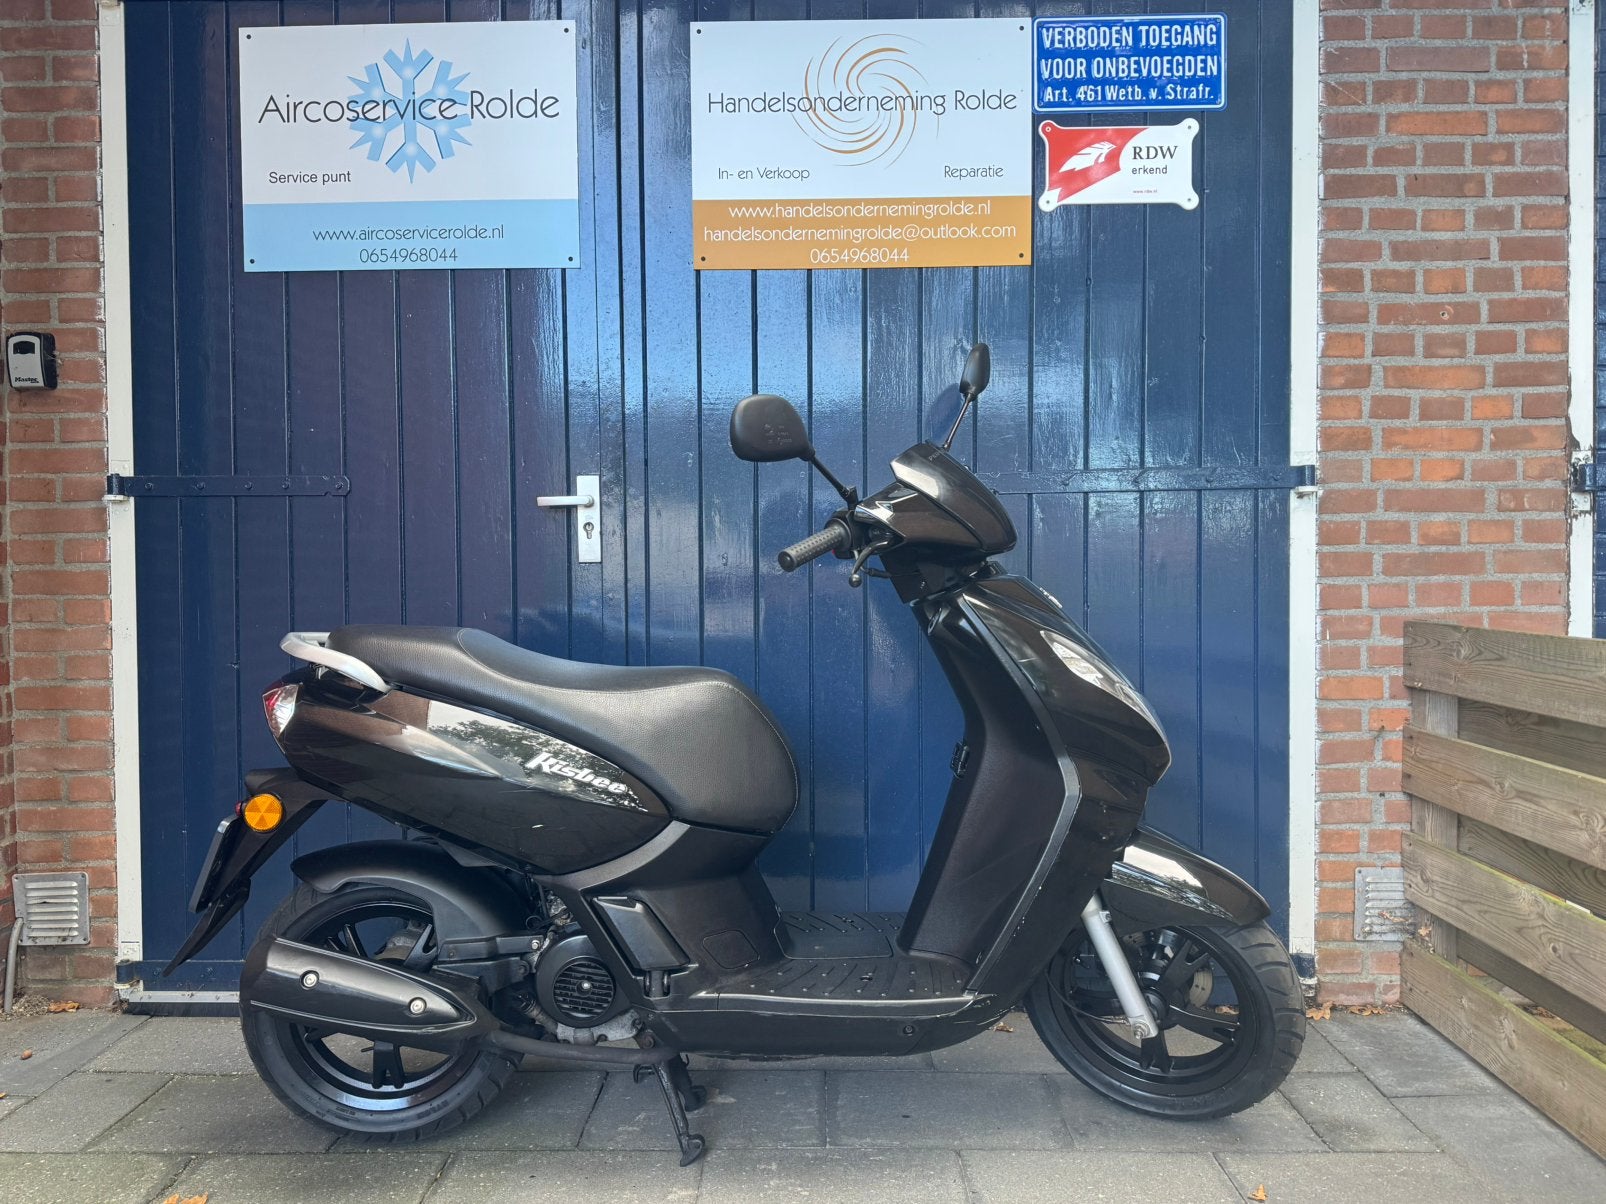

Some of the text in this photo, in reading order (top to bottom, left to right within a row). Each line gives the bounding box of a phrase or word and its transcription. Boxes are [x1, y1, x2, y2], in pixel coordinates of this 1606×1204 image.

[1041, 24, 1217, 48] VERBODEN TOEGANG
[1040, 55, 1218, 79] VOOR ONBEVOEGDEN
[1044, 84, 1214, 102] Art. 461 Wetb. v. Strafr.
[258, 88, 560, 124] Aircoservice Rolde
[708, 89, 1018, 116] Handelsonderneming Rolde
[1132, 146, 1178, 160] RDW
[268, 171, 351, 186] Service punt
[718, 167, 810, 182] In- en Verkoop
[943, 165, 1004, 180] Reparatie
[1132, 165, 1168, 175] erkend
[728, 200, 991, 220] www.handelsondernemingrolde.nl
[312, 224, 504, 243] www.aircoservicerolde.nl
[703, 223, 1017, 244] handelsondernemingrolde@outlook.com
[359, 247, 458, 264] 0654968044
[810, 247, 909, 264] 0654968044
